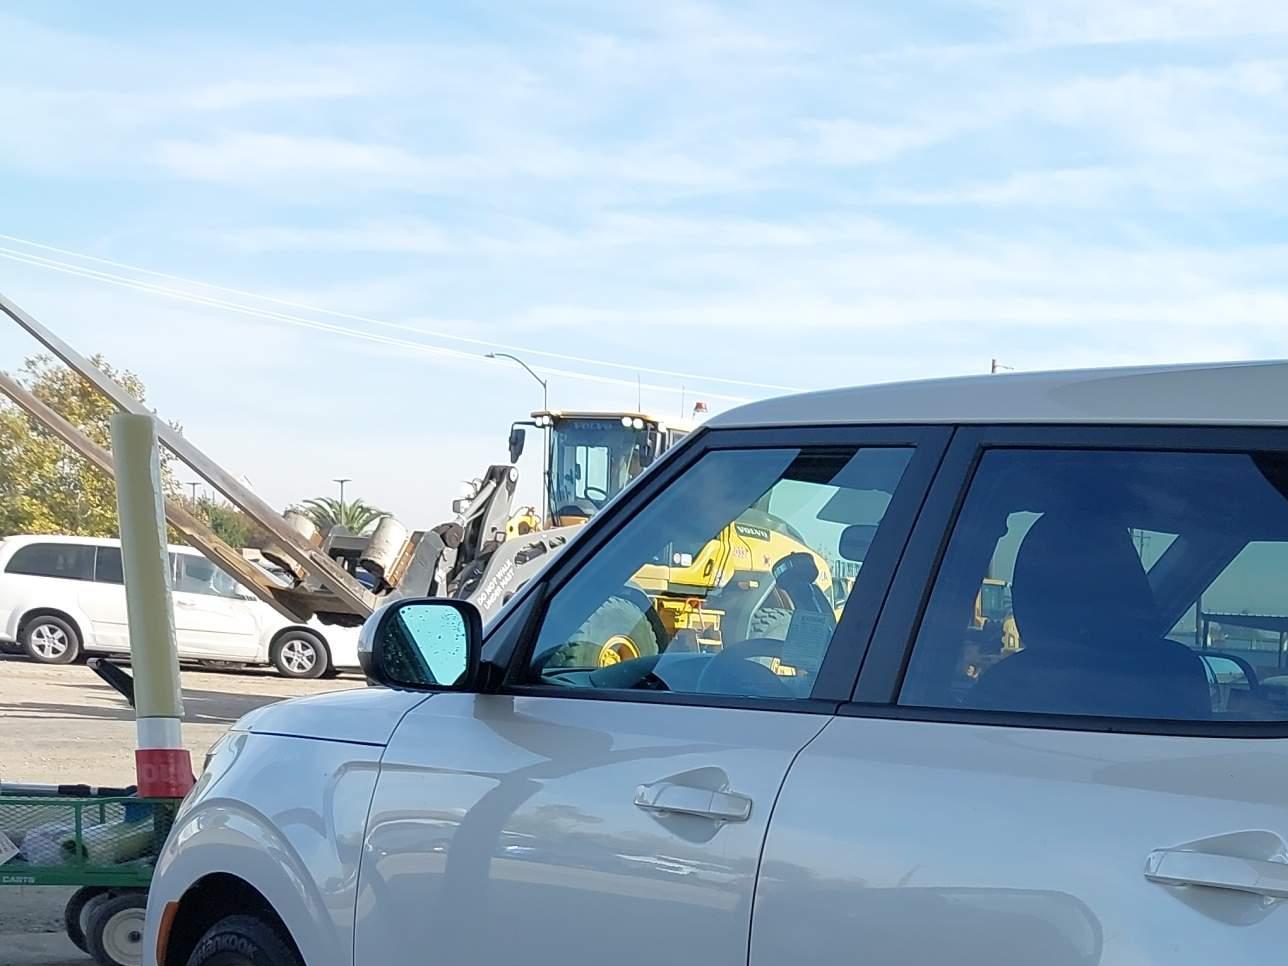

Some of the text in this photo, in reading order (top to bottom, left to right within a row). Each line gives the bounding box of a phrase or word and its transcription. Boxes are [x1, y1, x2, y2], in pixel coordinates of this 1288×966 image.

[736, 525, 768, 538] VOLVO
[477, 592, 487, 606] DO
[484, 577, 497, 595] NOT
